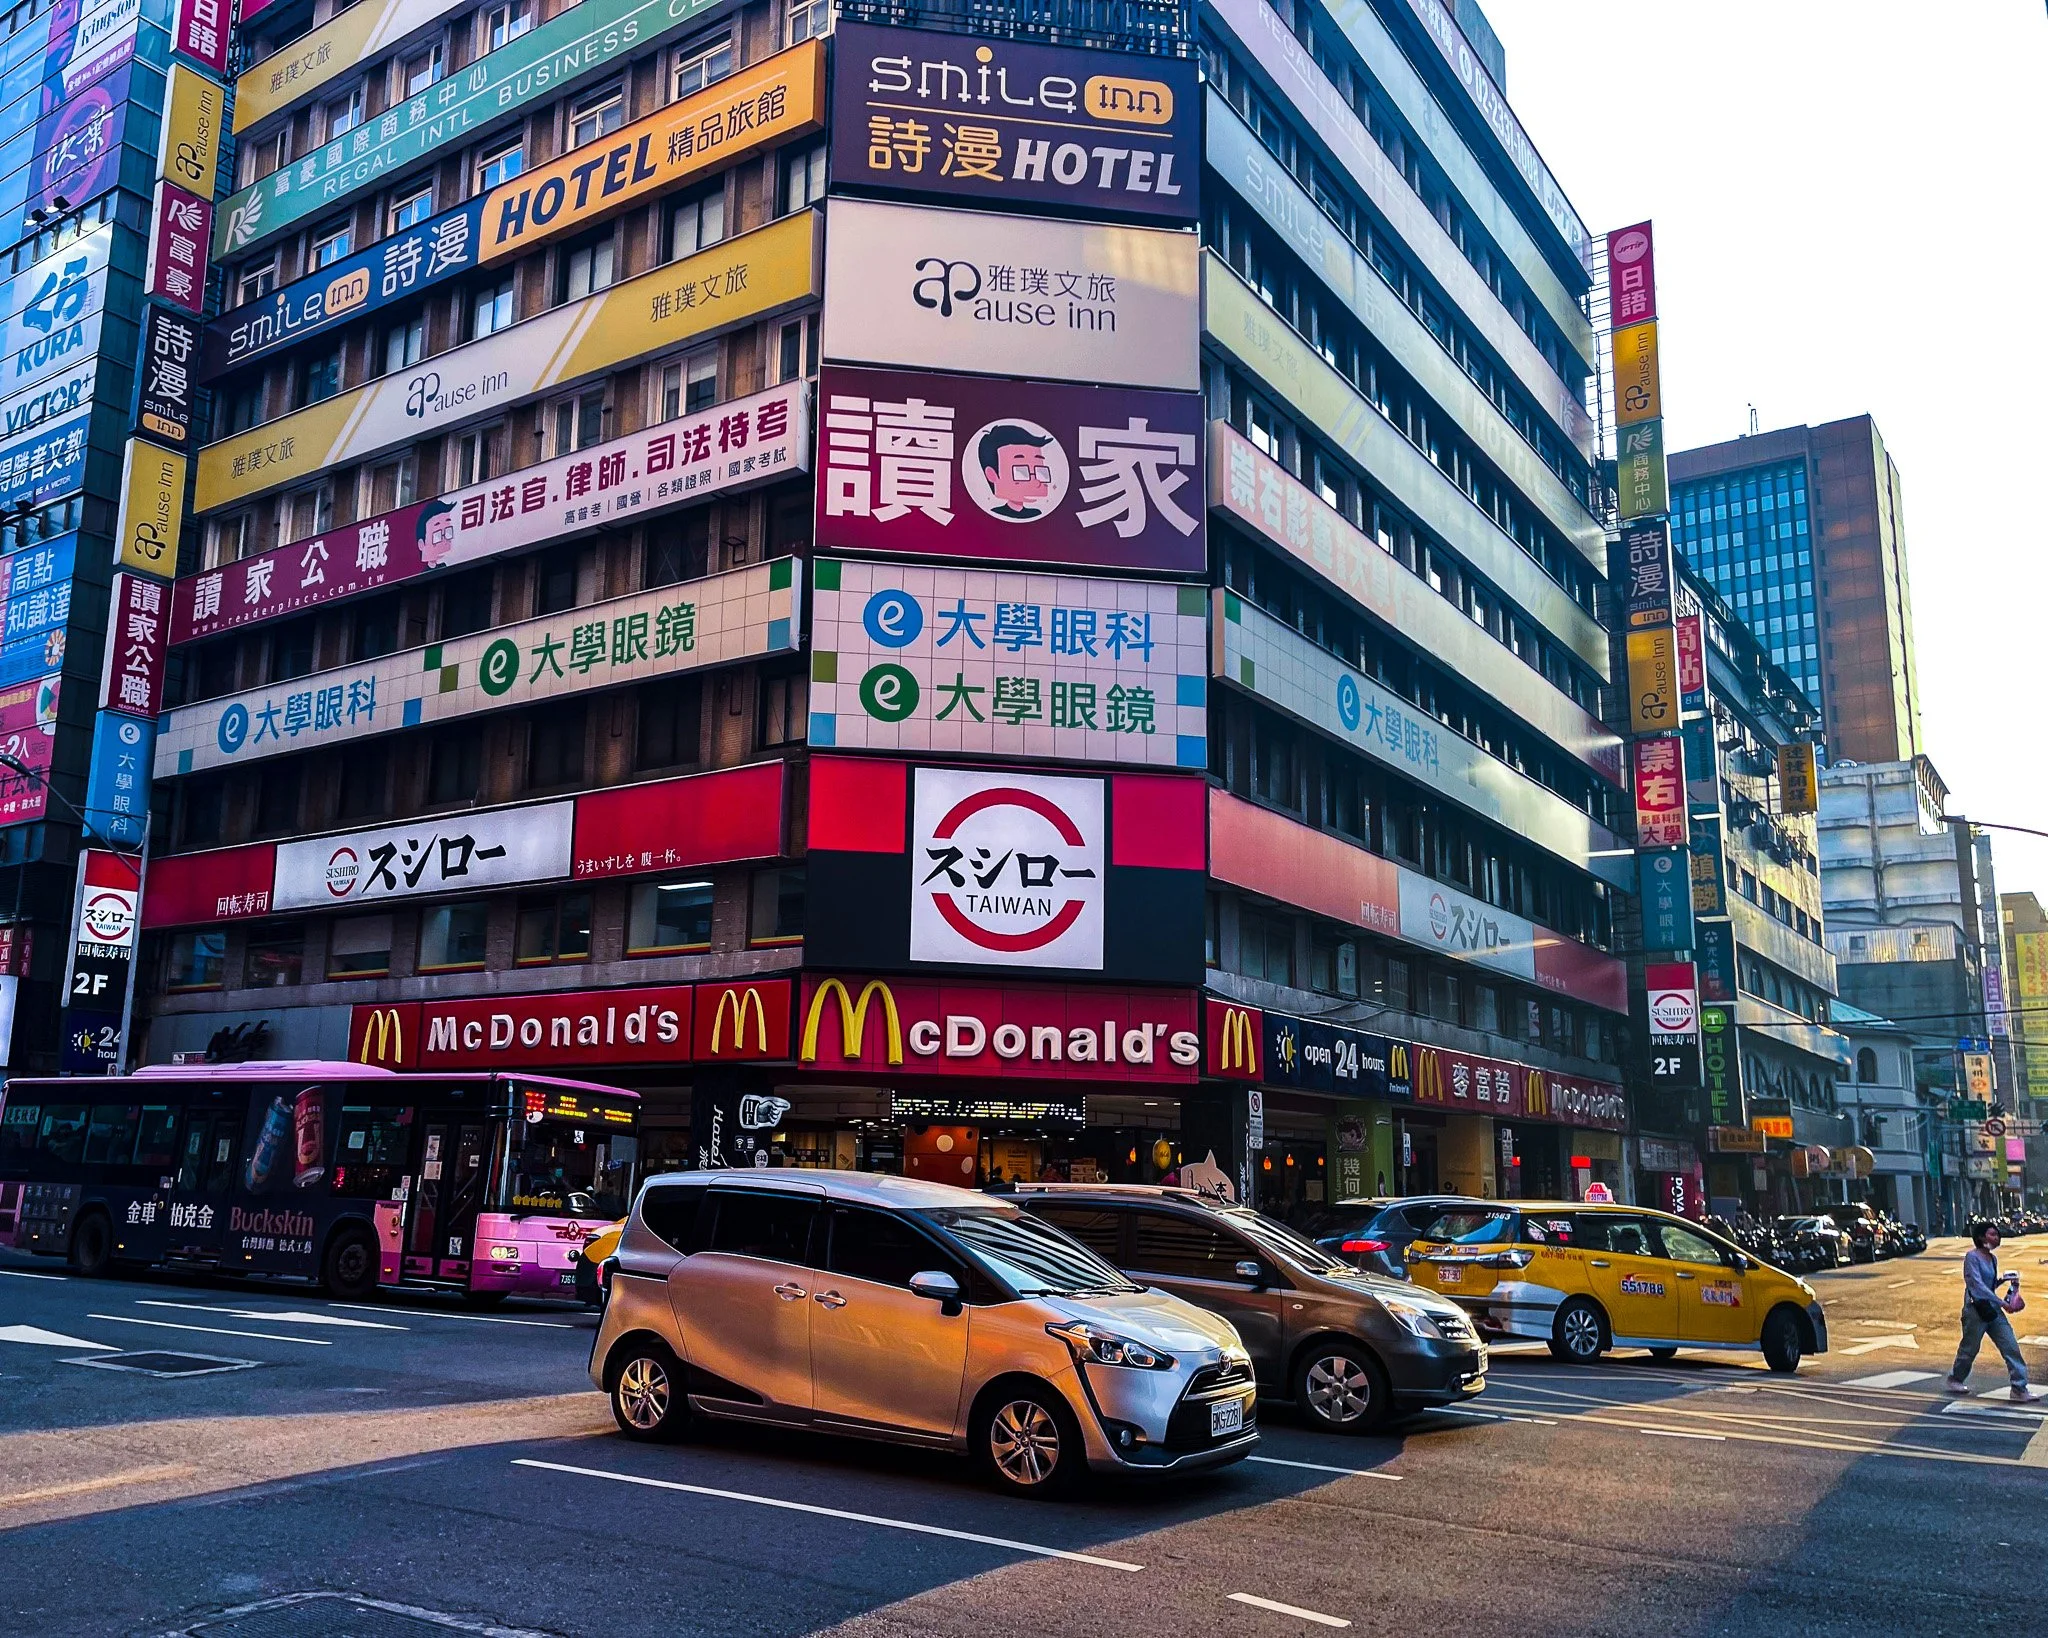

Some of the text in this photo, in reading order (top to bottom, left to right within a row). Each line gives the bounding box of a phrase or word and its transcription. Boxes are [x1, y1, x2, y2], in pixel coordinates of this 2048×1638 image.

[269, 40, 332, 94] 雅璞文旅
[1259, 1, 1316, 87] REGAL
[323, 20, 639, 197] REGAL INTL BUSINESS
[667, 84, 787, 166] 精品旅館
[868, 115, 1003, 182] 詩漫
[1012, 138, 1182, 195] HOTEL
[495, 133, 657, 245] HOTEL
[165, 233, 197, 300] 富豪
[382, 212, 469, 296] 詩漫
[649, 264, 748, 323] 雅璞文旅
[987, 264, 1116, 303] 雅璞文旅
[1620, 265, 1647, 318] 日語
[1069, 301, 1116, 332] inn
[16, 320, 83, 377] KURA
[148, 315, 193, 406] 詩漫
[481, 370, 508, 390] inn
[231, 436, 294, 480] 雅璞文旅
[564, 502, 601, 525] 高普考
[728, 447, 787, 478] 國家考試
[1076, 417, 1200, 538] 家
[1633, 452, 1651, 511] 商務中心
[12, 549, 54, 595] 高點
[192, 519, 390, 622] 讀家公職
[1629, 531, 1666, 598] 詩漫
[7, 583, 71, 636] 知識達
[191, 573, 385, 635] www.readerplace.com.tw
[936, 599, 1155, 663] 大學眼科
[120, 580, 161, 708] 讀家公職
[528, 602, 695, 685] 大學眼鏡
[254, 675, 376, 744] 大學眼科
[935, 673, 1156, 735] 大學眼鏡
[1365, 695, 1440, 777] 大學眼科
[110, 752, 136, 836] 大學眼科
[1641, 741, 1676, 805] 崇右
[362, 833, 507, 893] スシロー
[1643, 825, 1682, 845] 大學
[326, 864, 359, 880] SUSHIRO
[920, 845, 1097, 890] スシロー
[95, 922, 121, 931] TAIWAN
[216, 890, 269, 917] 回転寿司
[966, 894, 1052, 917] TAIWAN
[1360, 900, 1398, 932] 回転寿司
[1451, 903, 1511, 955] スシロー
[1656, 879, 1675, 945] 大學眼科
[77, 943, 131, 960] 回転寿司
[73, 972, 108, 995] 2F
[1651, 1007, 1694, 1017] SUSHIRO
[427, 1005, 679, 1051] McDonald's
[1652, 1034, 1696, 1046] 回転寿司
[1304, 1039, 1385, 1079] open 24 hours
[1452, 1061, 1511, 1104] 麥當勞
[1654, 1057, 1681, 1076] 2F
[1706, 1038, 1730, 1125] HOTEL
[1344, 1157, 1360, 1194] 幾何
[126, 1200, 215, 1229] 金車 柏克金
[229, 1206, 314, 1236] Buckskin
